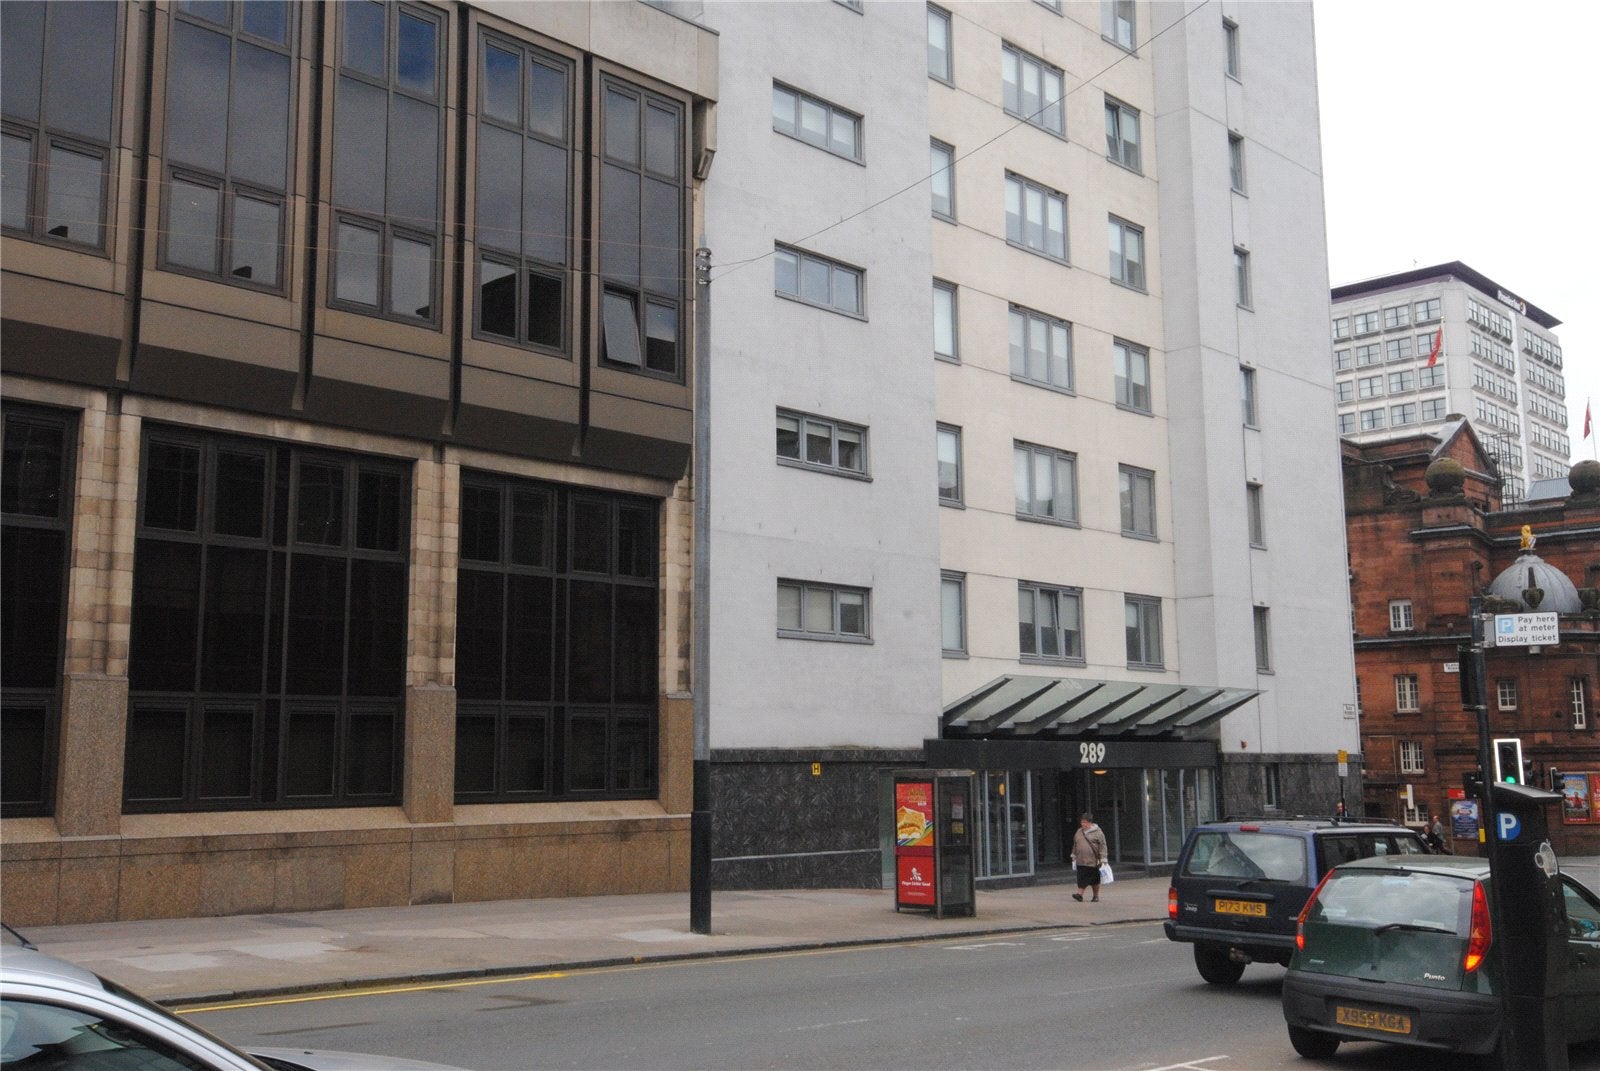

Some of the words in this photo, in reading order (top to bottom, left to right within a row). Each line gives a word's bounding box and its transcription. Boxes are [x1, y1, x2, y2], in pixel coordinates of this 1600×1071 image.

[1518, 616, 1533, 624] Pay
[1498, 635, 1528, 643] Display
[1080, 742, 1105, 764] 289
[1500, 812, 1517, 839] P
[1218, 901, 1241, 912] P173
[1423, 972, 1446, 982] Punto
